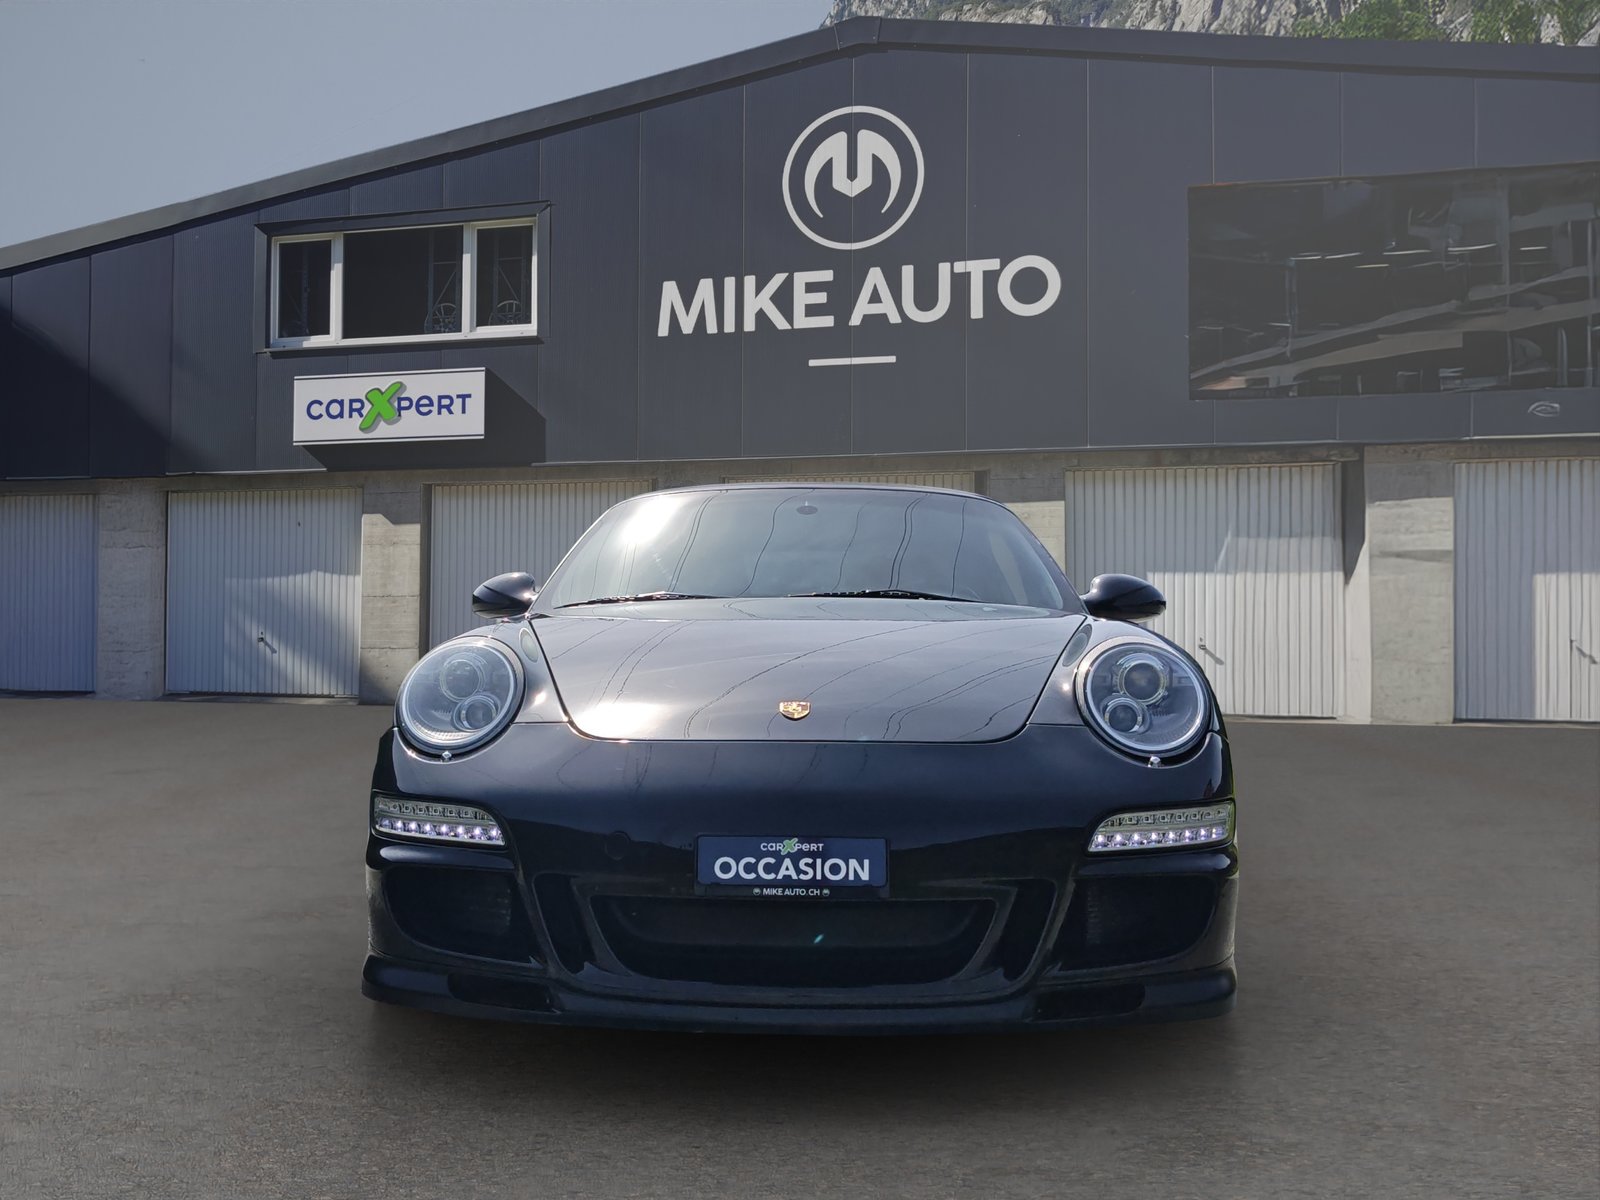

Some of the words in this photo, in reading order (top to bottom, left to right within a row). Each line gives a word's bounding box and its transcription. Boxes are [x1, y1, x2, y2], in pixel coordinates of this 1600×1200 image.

[657, 269, 835, 337] MIKE
[848, 254, 1062, 327] AUTO
[714, 856, 870, 881] OCCASION
[762, 887, 783, 896] MIKE
